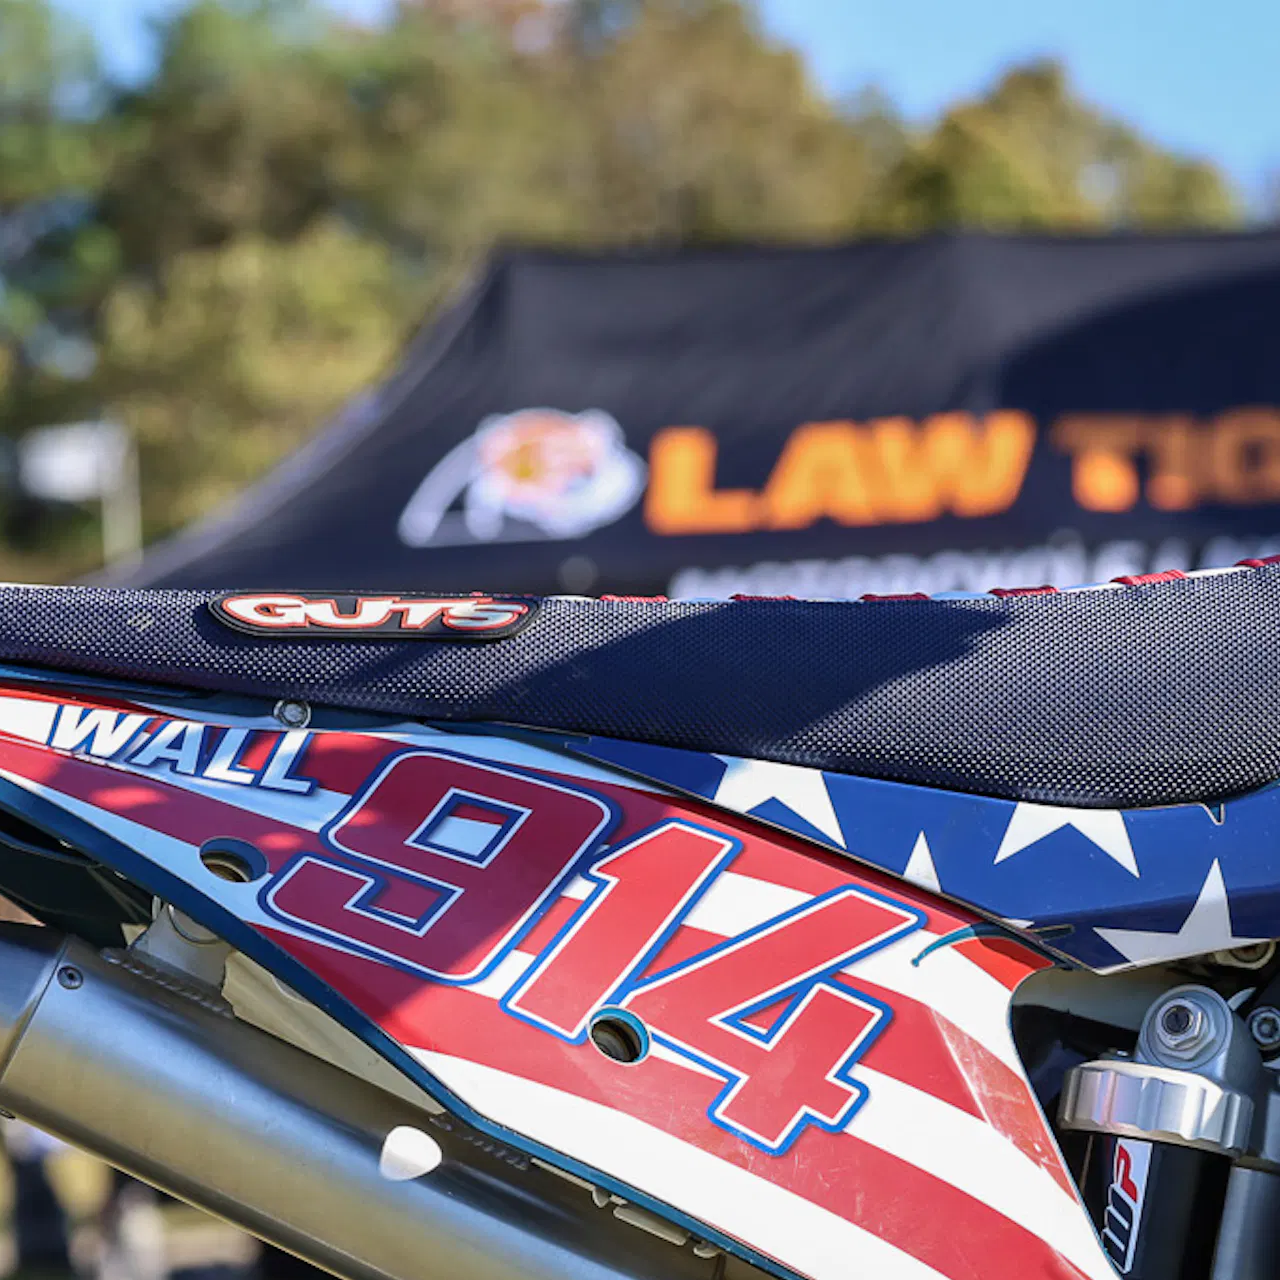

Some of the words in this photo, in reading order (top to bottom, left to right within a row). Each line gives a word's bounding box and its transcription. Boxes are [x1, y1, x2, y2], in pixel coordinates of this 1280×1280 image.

[644, 408, 1038, 536] LAW
[220, 594, 528, 630] GUTS
[46, 702, 320, 796] WALL
[257, 744, 928, 1157] 914
